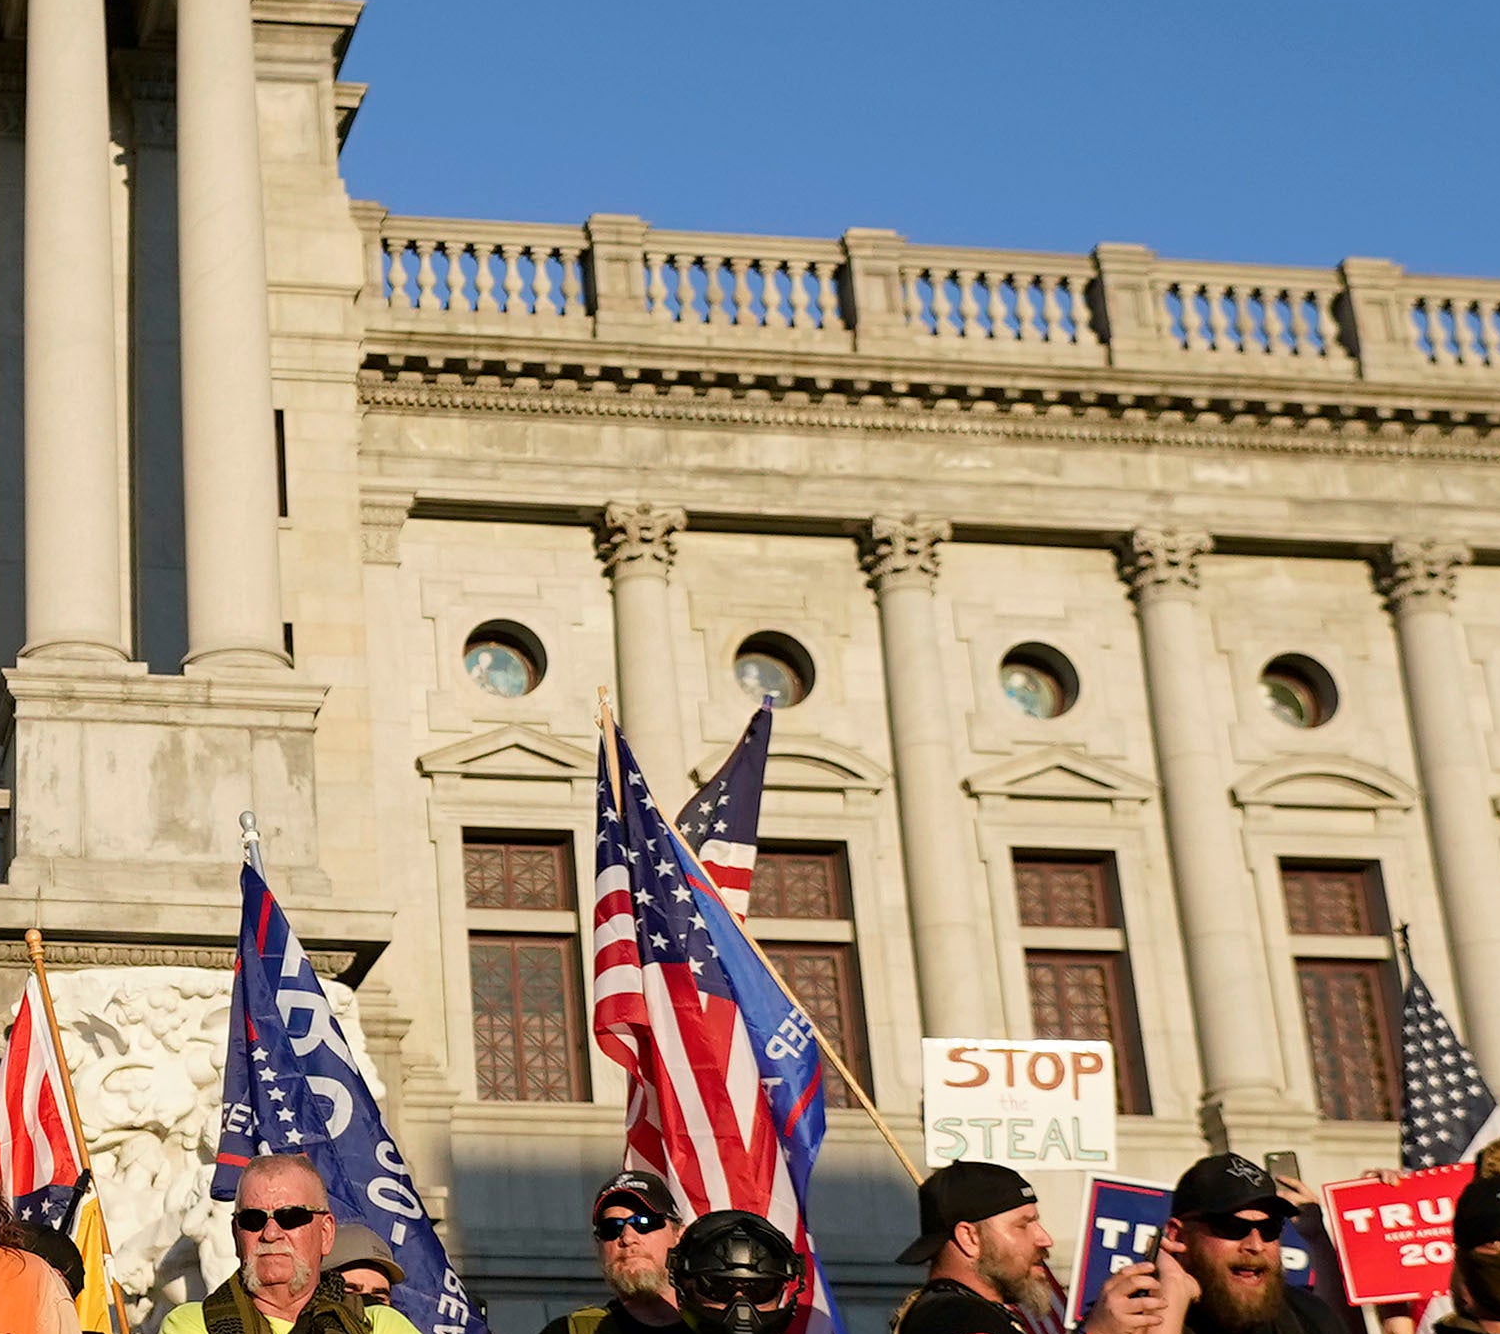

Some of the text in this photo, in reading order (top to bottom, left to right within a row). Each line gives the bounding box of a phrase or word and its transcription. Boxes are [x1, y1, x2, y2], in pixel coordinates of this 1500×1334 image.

[943, 1045, 1104, 1101] STOP
[932, 1115, 1109, 1162] STEAL
[1341, 1196, 1455, 1235] TRU
[1399, 1241, 1455, 1267] 20
